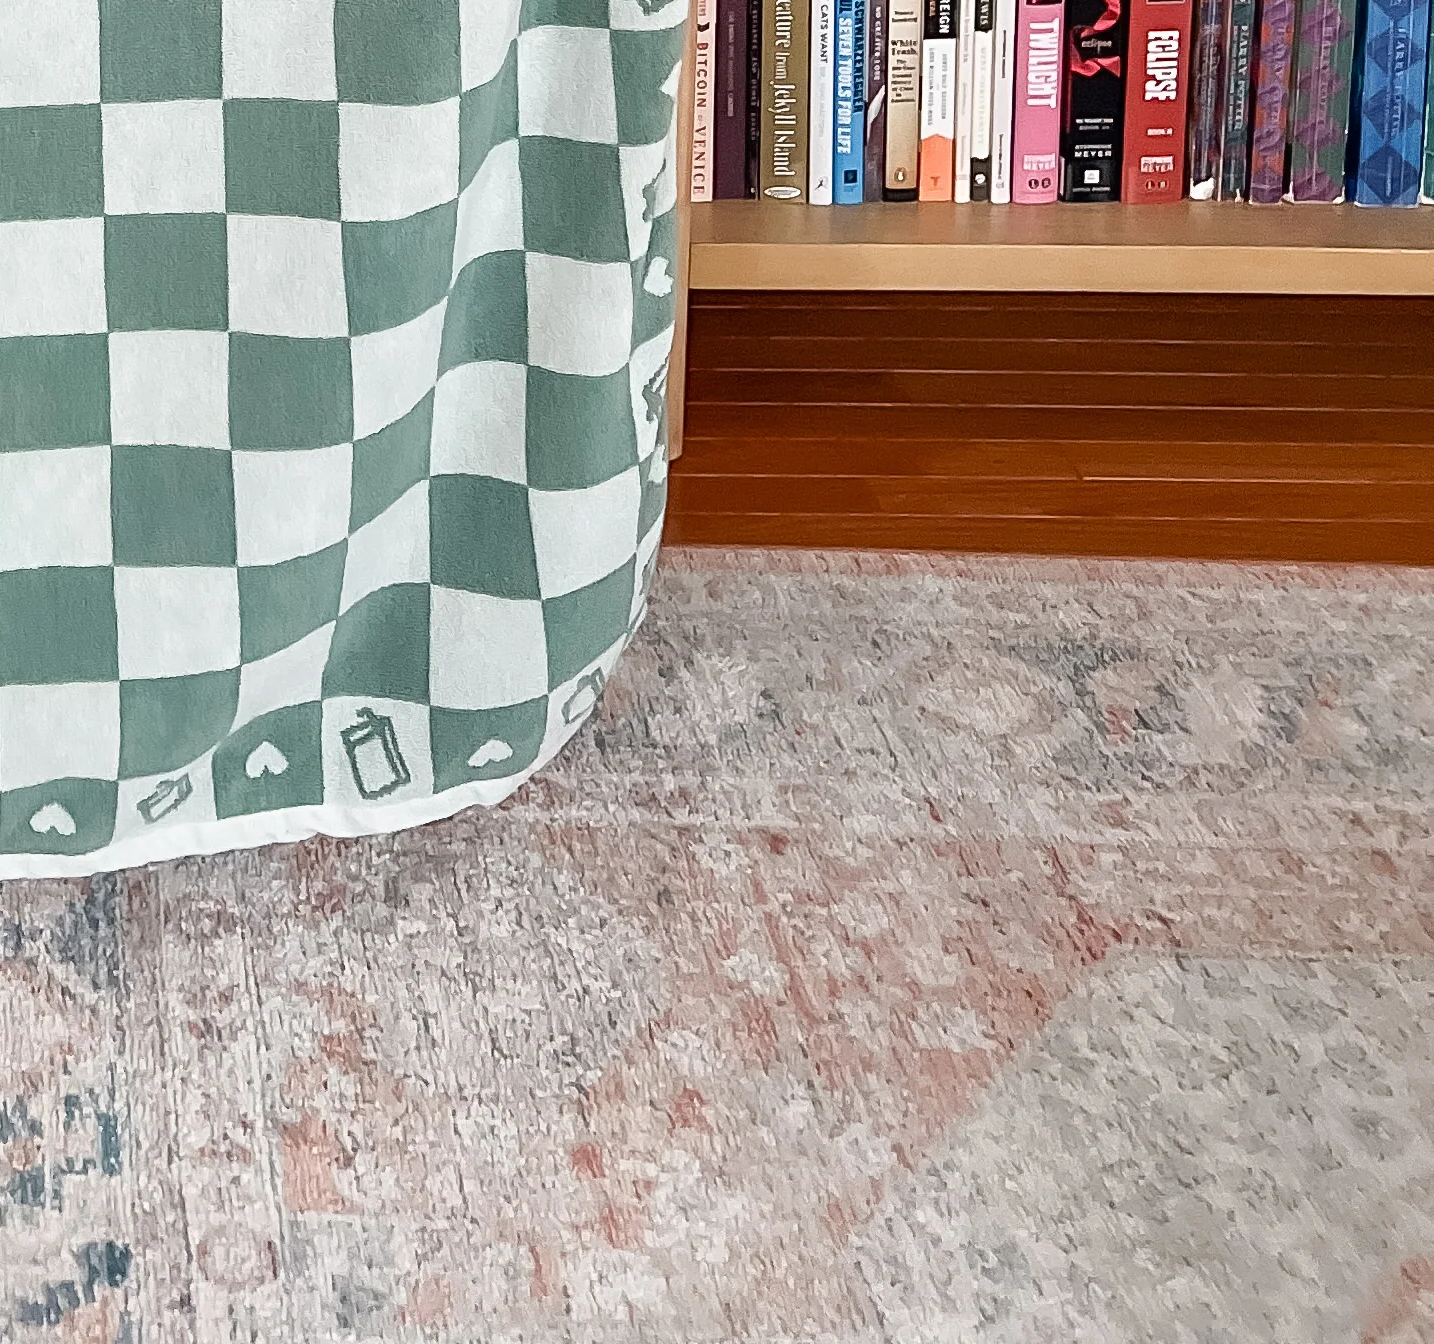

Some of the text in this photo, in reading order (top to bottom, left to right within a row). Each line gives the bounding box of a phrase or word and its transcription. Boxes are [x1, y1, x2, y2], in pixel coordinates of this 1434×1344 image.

[820, 5, 828, 30] CATS
[820, 34, 828, 63] WANT
[838, 18, 852, 55] SEVEN
[774, 52, 790, 80] from
[838, 59, 851, 97] TOOLS
[1027, 18, 1060, 108] TWILIGHT
[1145, 30, 1178, 100] ECLIPSE
[694, 42, 708, 195] BITCOIN VENICE
[768, 81, 796, 124] Jekyll
[838, 101, 851, 124] FOR
[774, 130, 795, 176] Island
[838, 128, 850, 154] LIFE
